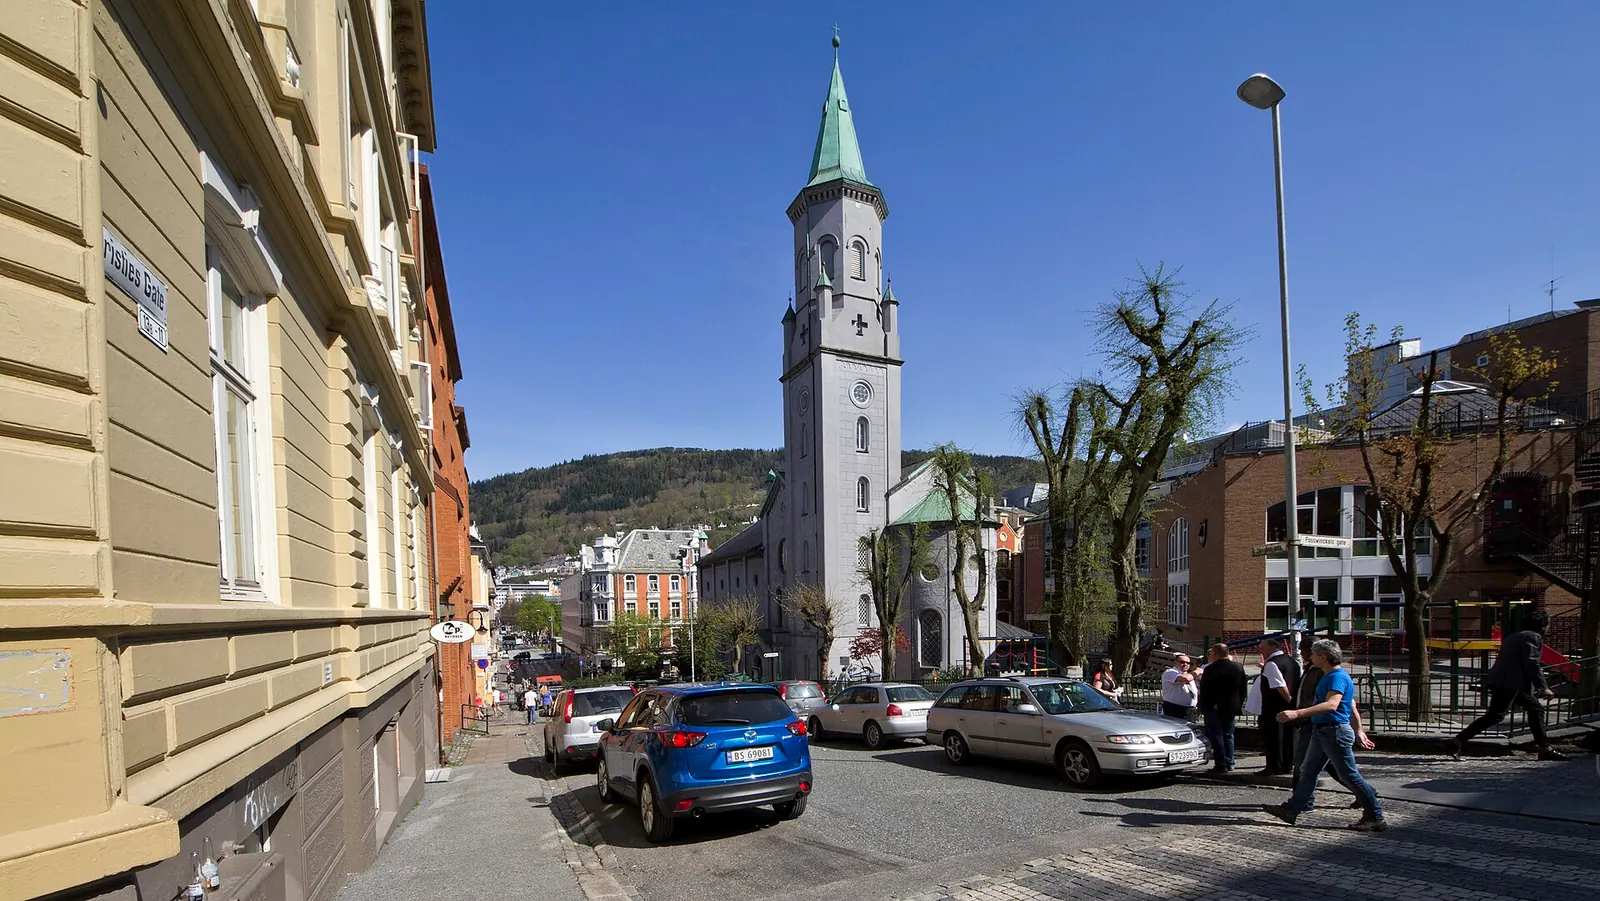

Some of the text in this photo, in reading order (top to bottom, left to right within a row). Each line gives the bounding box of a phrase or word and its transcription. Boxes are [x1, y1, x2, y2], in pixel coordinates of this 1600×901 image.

[143, 271, 165, 311] Gate
[734, 748, 771, 761] BS 69081
